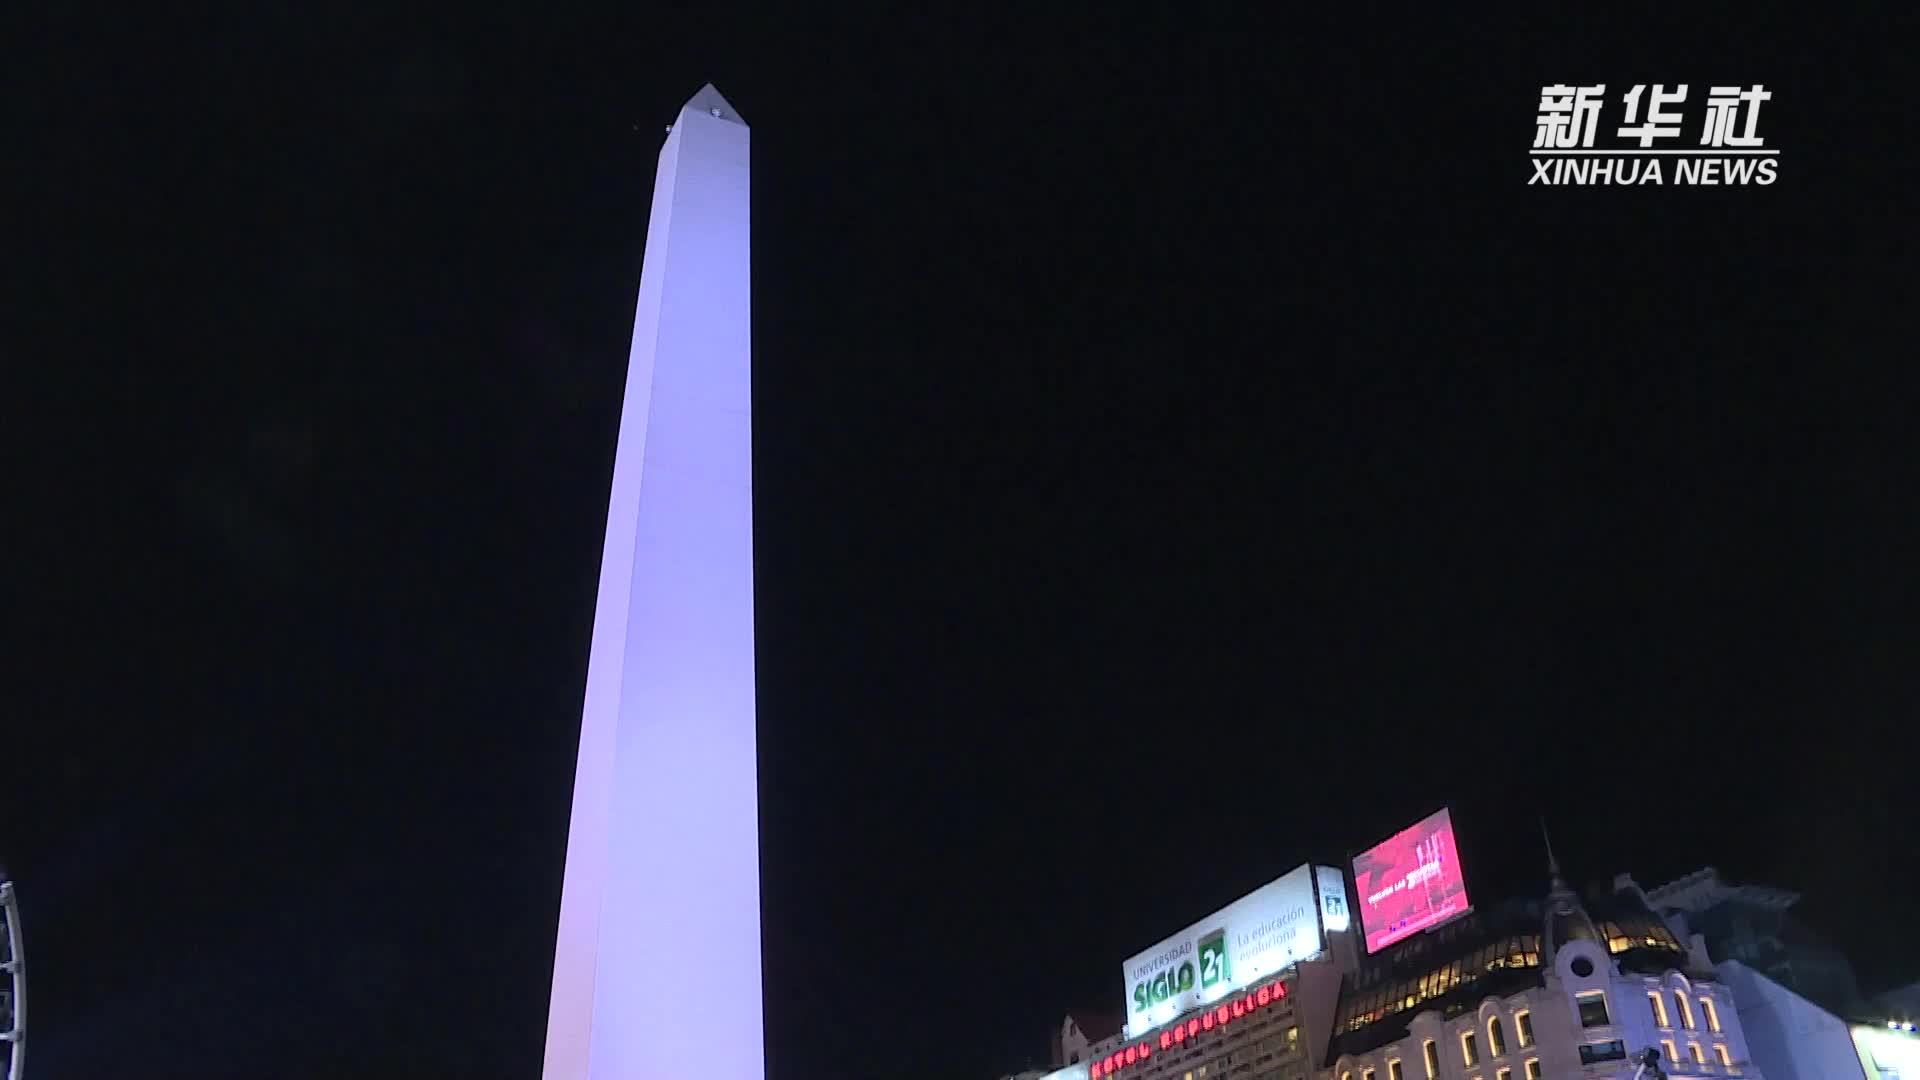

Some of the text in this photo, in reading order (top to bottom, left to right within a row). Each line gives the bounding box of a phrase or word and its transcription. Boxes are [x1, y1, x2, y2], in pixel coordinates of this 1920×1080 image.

[1237, 904, 1304, 948] La educación
[1240, 926, 1297, 961] evoluciona
[1133, 941, 1192, 980] UNIVERSIDAD
[1134, 948, 1225, 1013] SIGLO 21
